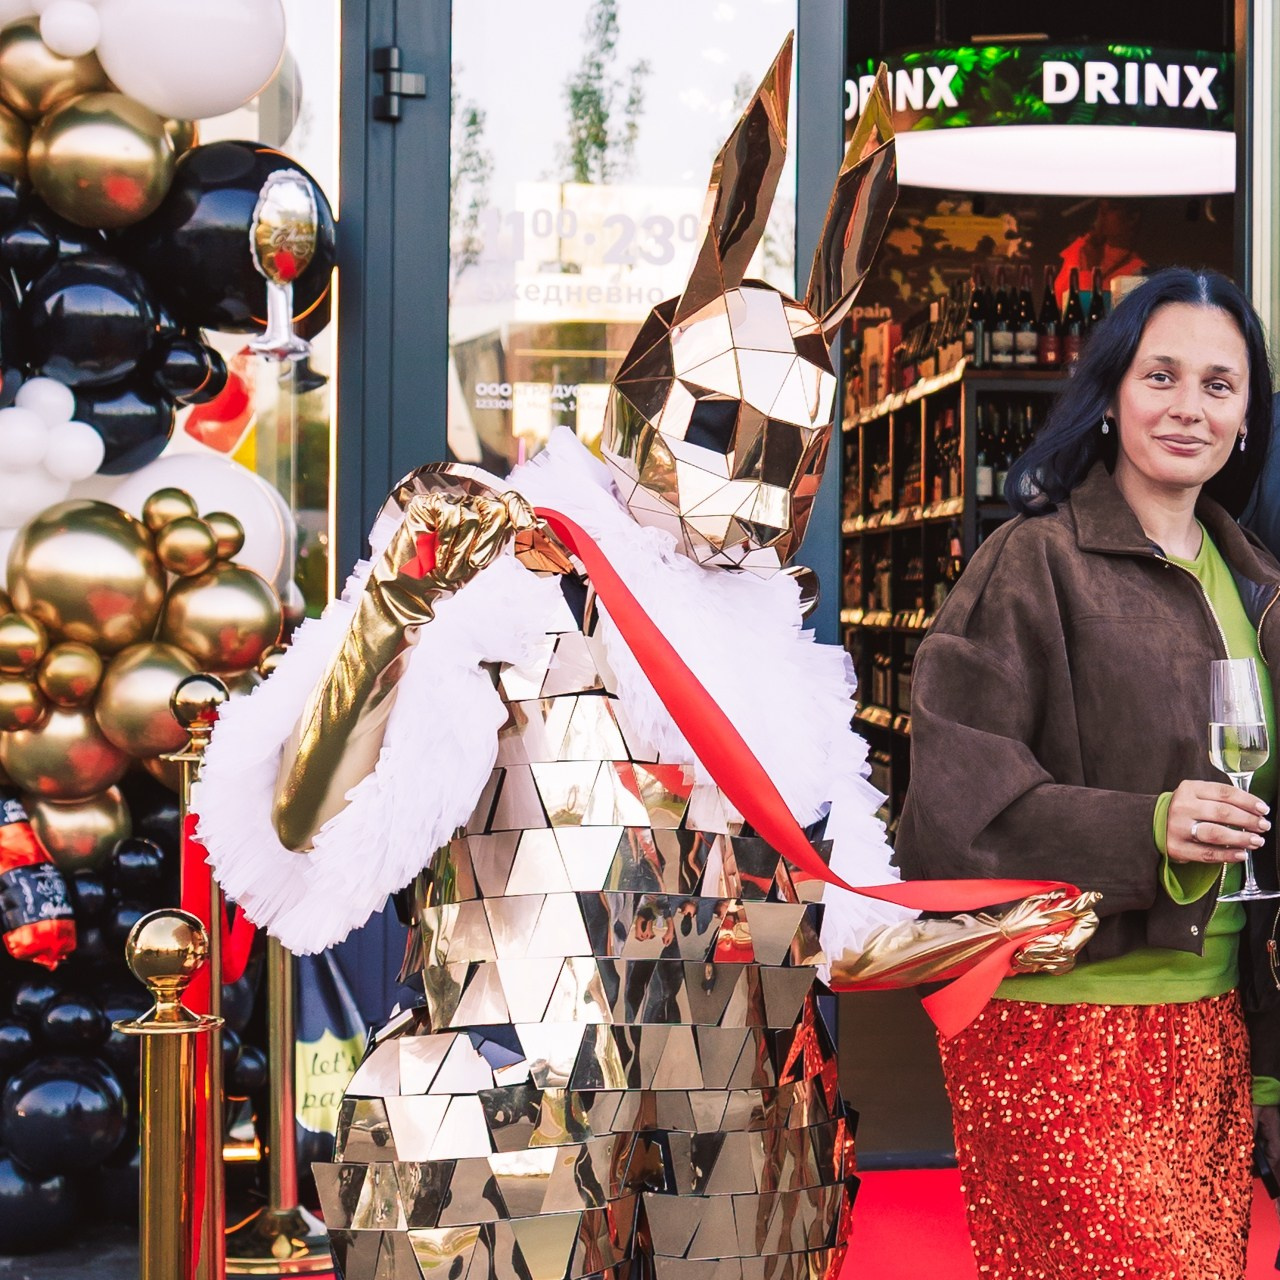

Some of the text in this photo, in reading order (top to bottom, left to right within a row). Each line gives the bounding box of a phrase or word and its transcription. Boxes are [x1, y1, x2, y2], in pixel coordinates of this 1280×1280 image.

[1042, 60, 1219, 110] DRINX
[846, 302, 892, 324] pain
[475, 382, 513, 397] ООО
